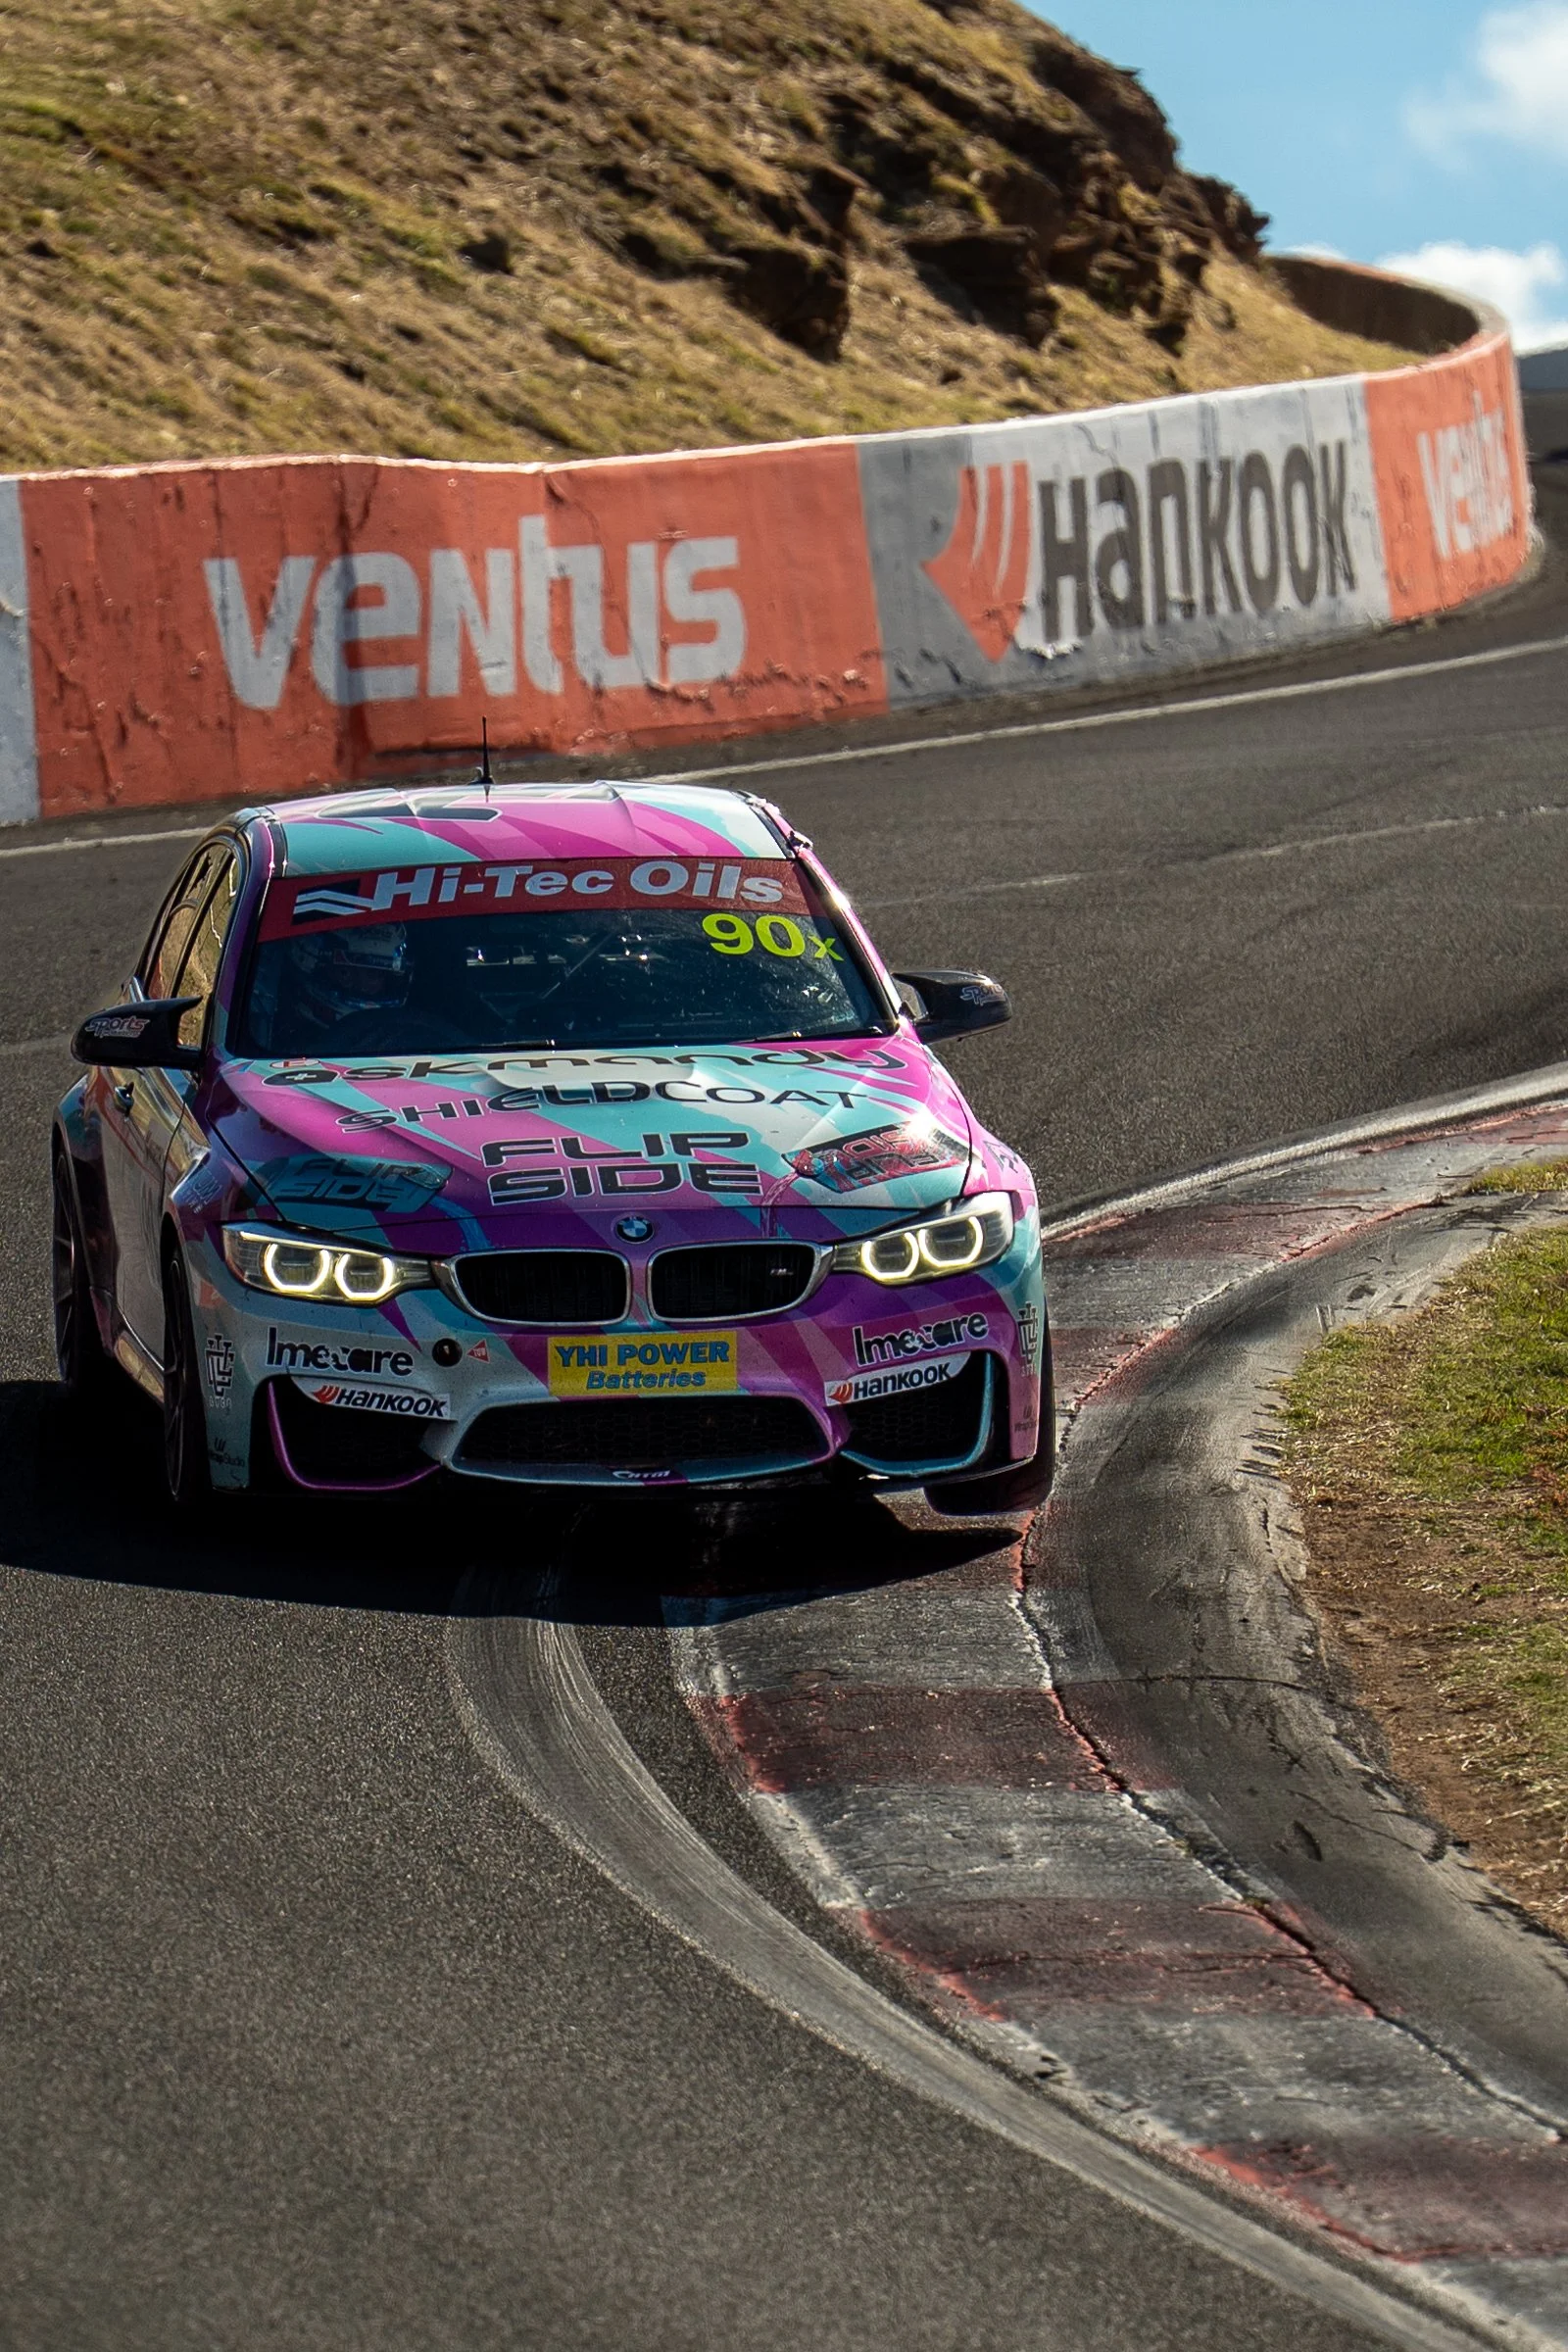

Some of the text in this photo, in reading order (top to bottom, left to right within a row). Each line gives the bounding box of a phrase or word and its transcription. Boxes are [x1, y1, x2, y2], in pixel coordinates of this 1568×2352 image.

[369, 859, 784, 909] Hi-Tec Oils
[335, 1079, 867, 1134] SHIELDCOAT
[482, 1132, 750, 1167] FLIP
[277, 1178, 405, 1201] SIDE
[487, 1162, 763, 1206] SIDE
[557, 1341, 730, 1368] YHI POWER
[587, 1368, 707, 1390] Batteries
